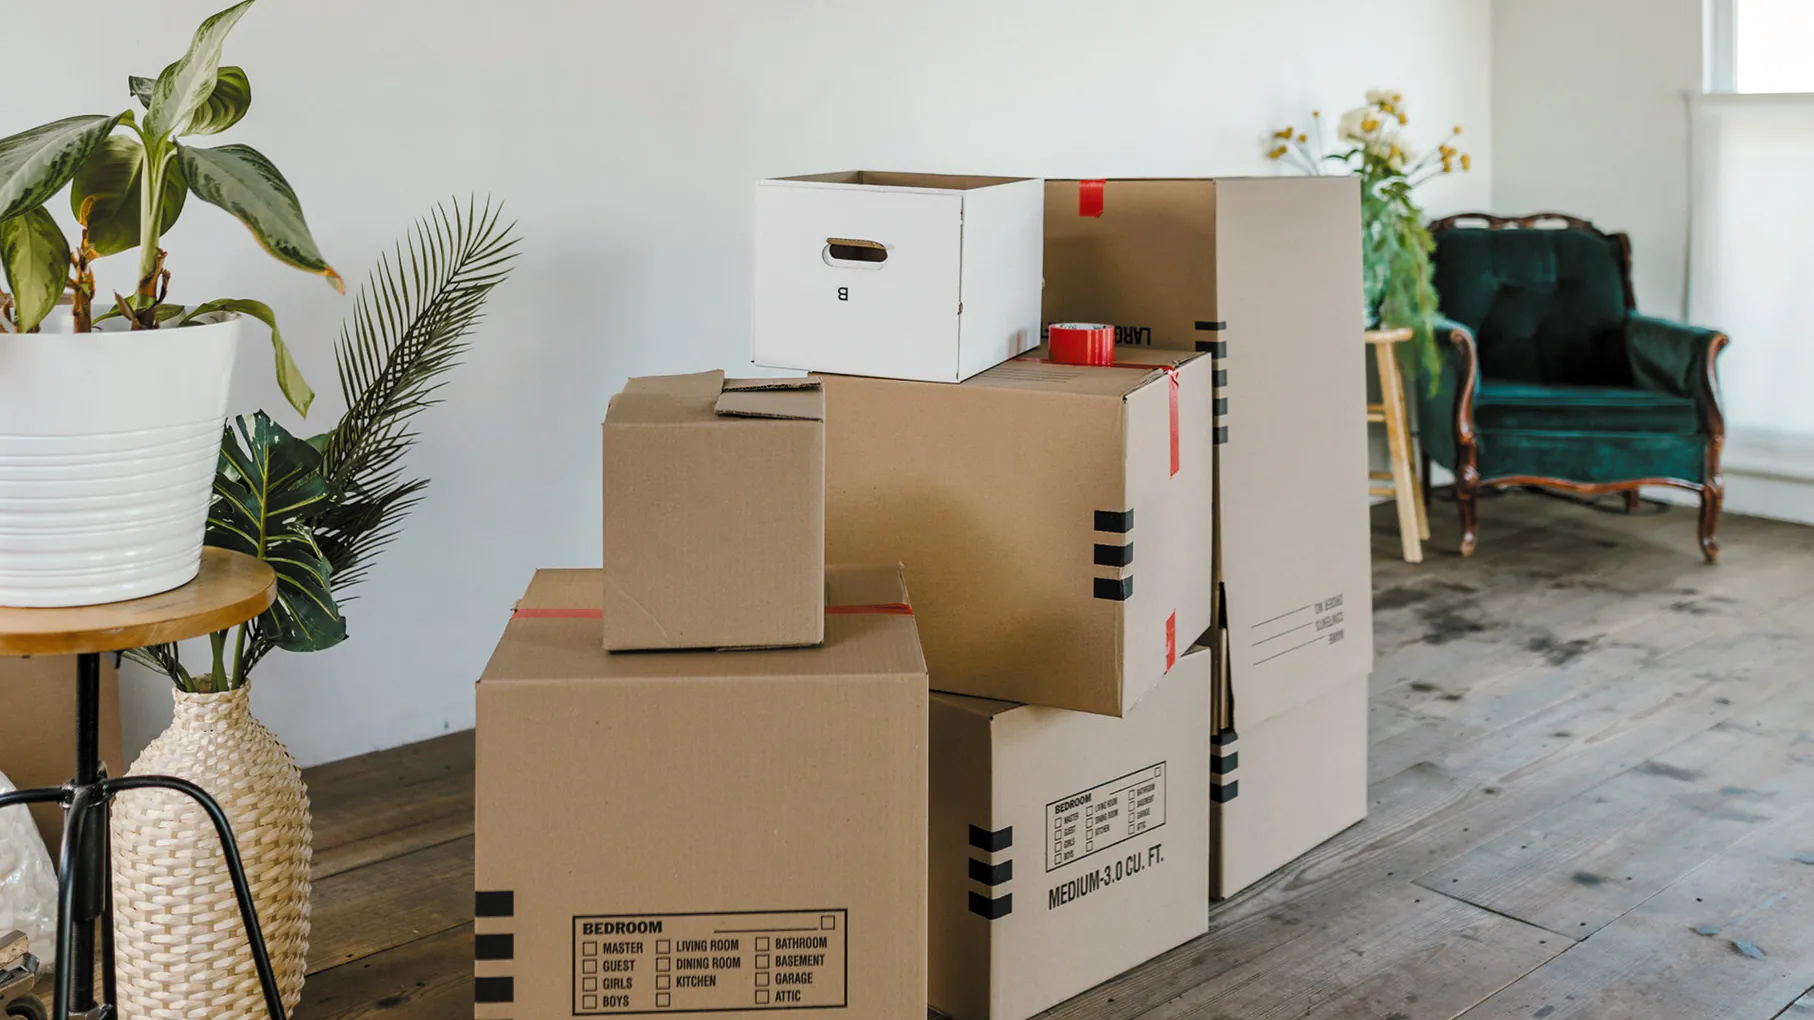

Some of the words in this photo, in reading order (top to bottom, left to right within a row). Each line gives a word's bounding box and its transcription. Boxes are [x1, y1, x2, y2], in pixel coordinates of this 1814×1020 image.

[837, 286, 849, 301] B
[1055, 793, 1092, 814] BEDROOM
[1049, 861, 1122, 910] MEDIUM-3.0
[1126, 852, 1145, 877] CU.
[1148, 843, 1164, 867] FT.
[583, 921, 663, 935] BEDROOM
[603, 942, 643, 954] MASTER
[676, 940, 707, 952] LIVING
[710, 939, 739, 951] ROOM
[775, 936, 828, 949] BATHROOM
[603, 960, 635, 972] GUEST
[676, 957, 709, 970] DINING
[712, 956, 741, 969] ROOM
[775, 954, 825, 967] BASEMENT
[603, 977, 632, 990] GIRLS
[676, 975, 716, 988] KITCHEN
[775, 972, 813, 985] GARAGE
[603, 995, 629, 1007] BOYS
[775, 990, 801, 1003] ATTIC
